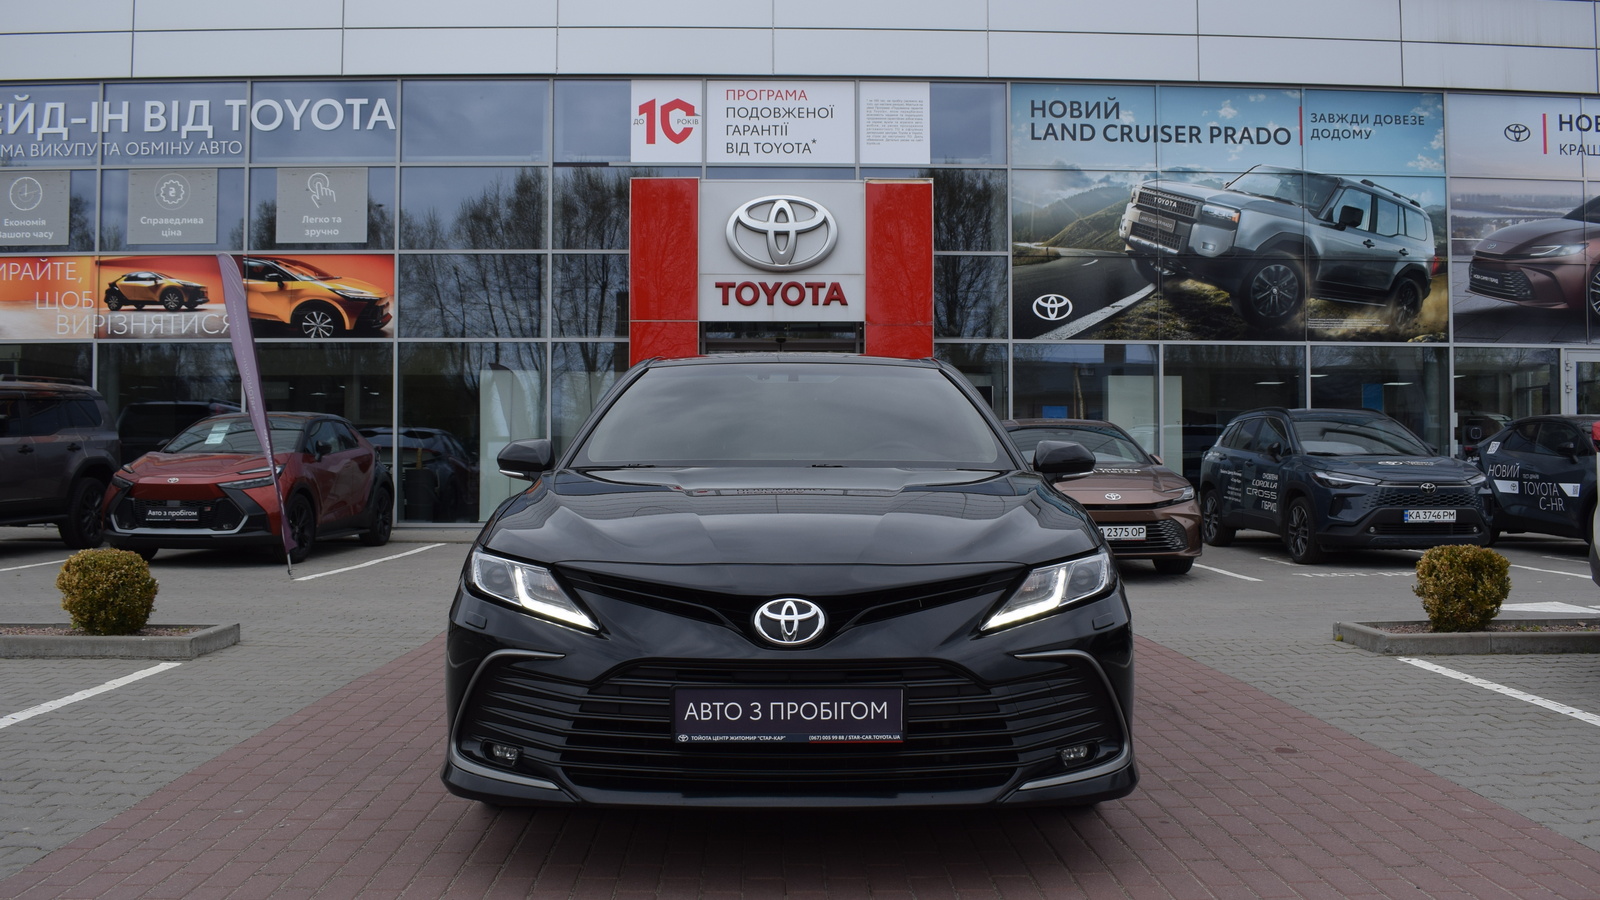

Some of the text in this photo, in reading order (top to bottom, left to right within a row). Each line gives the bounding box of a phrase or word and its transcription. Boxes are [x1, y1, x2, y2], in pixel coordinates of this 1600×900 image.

[726, 89, 808, 101] ПРОГРАМА
[726, 105, 834, 122] ПОДОВЖЕНОЇ
[1030, 97, 1120, 120] НОВИЙ
[0, 94, 396, 141] ЙД-ІН ВІД TOYOTA
[1310, 113, 1425, 126] ЗАВЖДИ ДОВЕЗЕ
[726, 123, 788, 136] ГАРАНТІЇ
[1030, 122, 1292, 145] LAND CRUISER PRADO
[1310, 128, 1372, 141] ДОДОМУ
[30, 143, 98, 157] ВИКУПУ
[102, 142, 121, 156] ТА
[126, 141, 194, 156] ОБМІНУ
[198, 140, 243, 155] АВТО
[726, 142, 750, 156] ВІД
[1153, 197, 1177, 208] TOYOTA
[4, 218, 47, 227] Економія
[140, 215, 204, 227] Справедлива
[302, 215, 329, 225] Легко
[0, 231, 54, 239] ашого часу
[161, 228, 182, 238] ціна
[304, 228, 339, 238] зручно
[715, 281, 848, 306] TOYOTA
[36, 291, 94, 313] ЩОБ
[56, 313, 231, 335] ВИРІЗНЯТИСЯ
[1487, 462, 1520, 478] НОВИЙ
[1252, 479, 1278, 489] COROLLA
[1523, 481, 1560, 496] TOYOTA
[1246, 487, 1277, 500] CROSS
[1539, 496, 1565, 511] C-HR
[168, 509, 197, 517] пробігом
[1408, 511, 1455, 519] KA 3746 PM
[1107, 527, 1130, 537] 2375
[1131, 527, 1145, 537] OP
[683, 701, 888, 721] АВТО З ПРОБІГОМ
